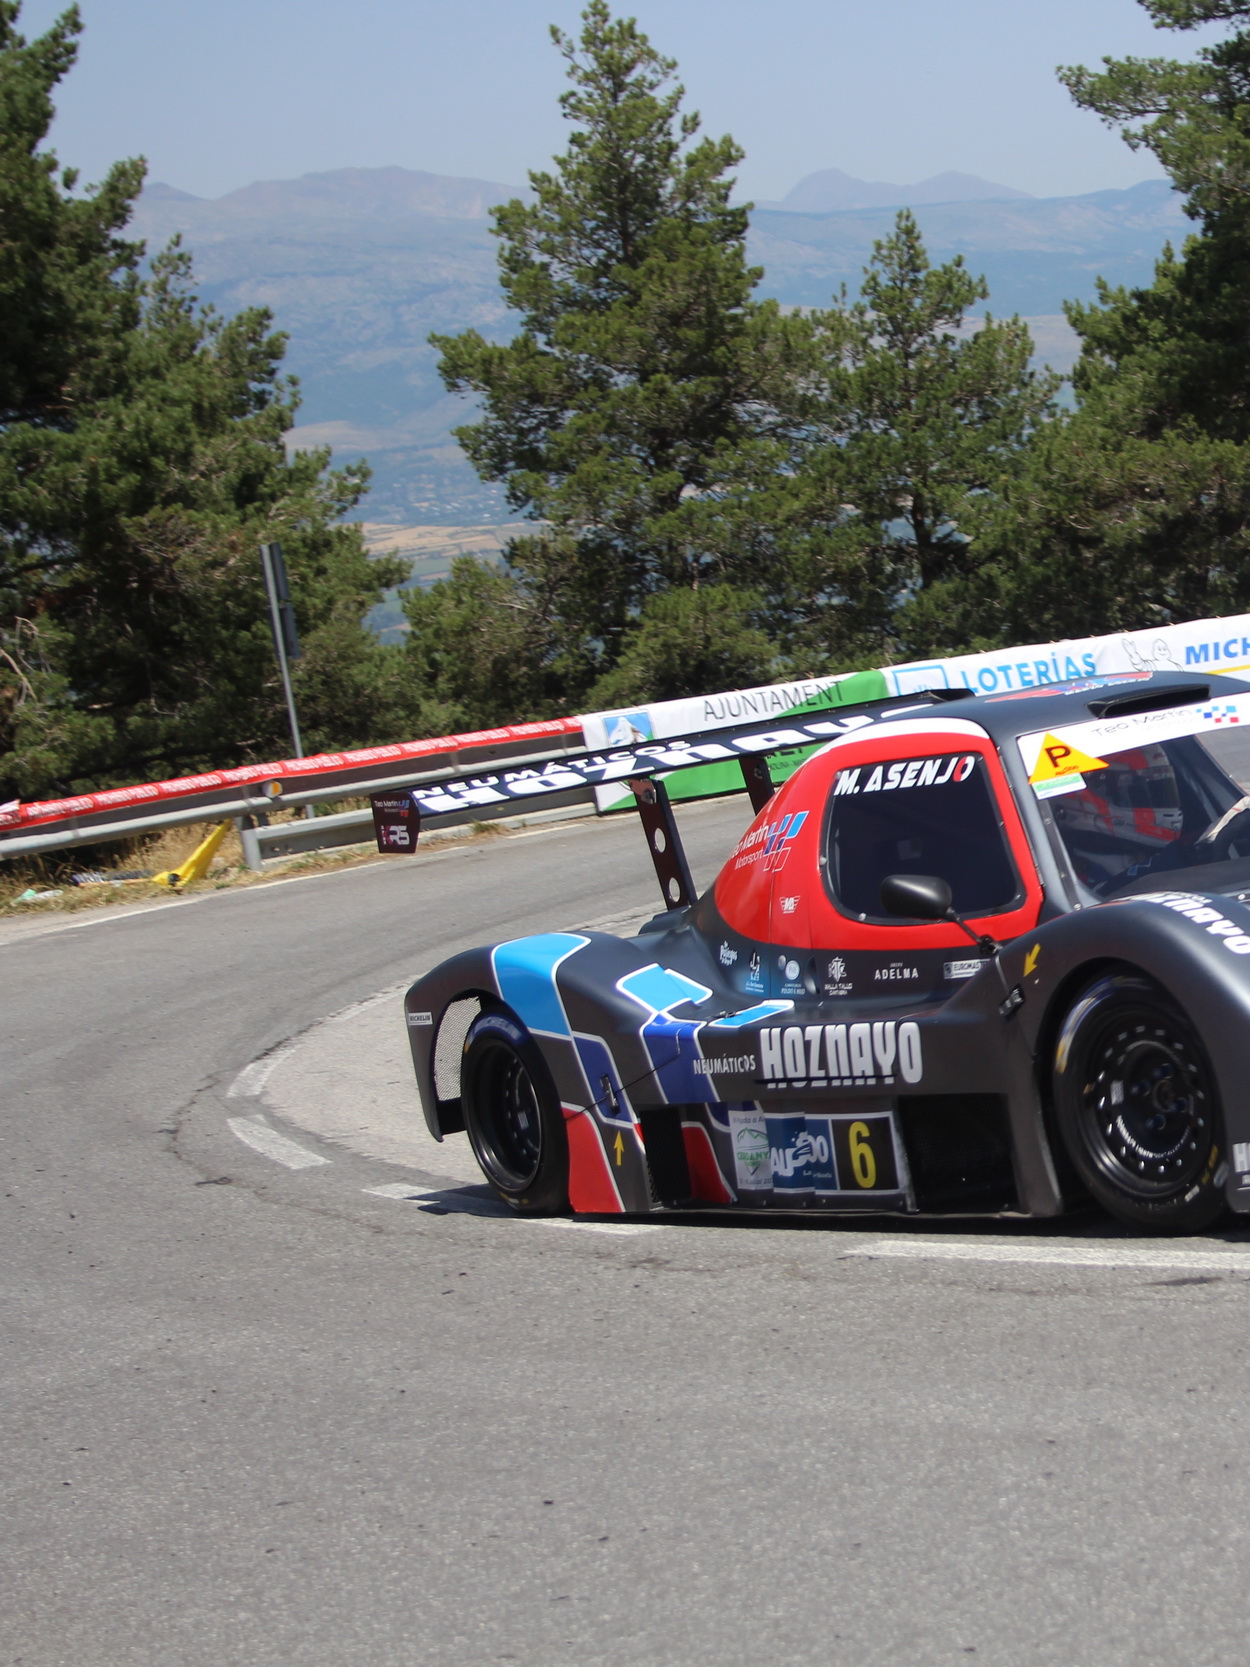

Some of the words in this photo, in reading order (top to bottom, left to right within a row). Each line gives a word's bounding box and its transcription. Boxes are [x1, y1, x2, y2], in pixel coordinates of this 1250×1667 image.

[961, 652, 1097, 695] LOTERÍAS
[703, 681, 843, 722] AJUNTAMENT
[412, 740, 692, 799] NEUMÁTICOS
[834, 768, 861, 796] M.
[863, 755, 975, 793] ASENJO
[1045, 745, 1072, 768] P
[874, 967, 919, 981] ADELMA
[693, 1053, 756, 1075] NEUMÁTICOS
[760, 1021, 923, 1089] HOZNAYO
[848, 1121, 877, 1189] 6
